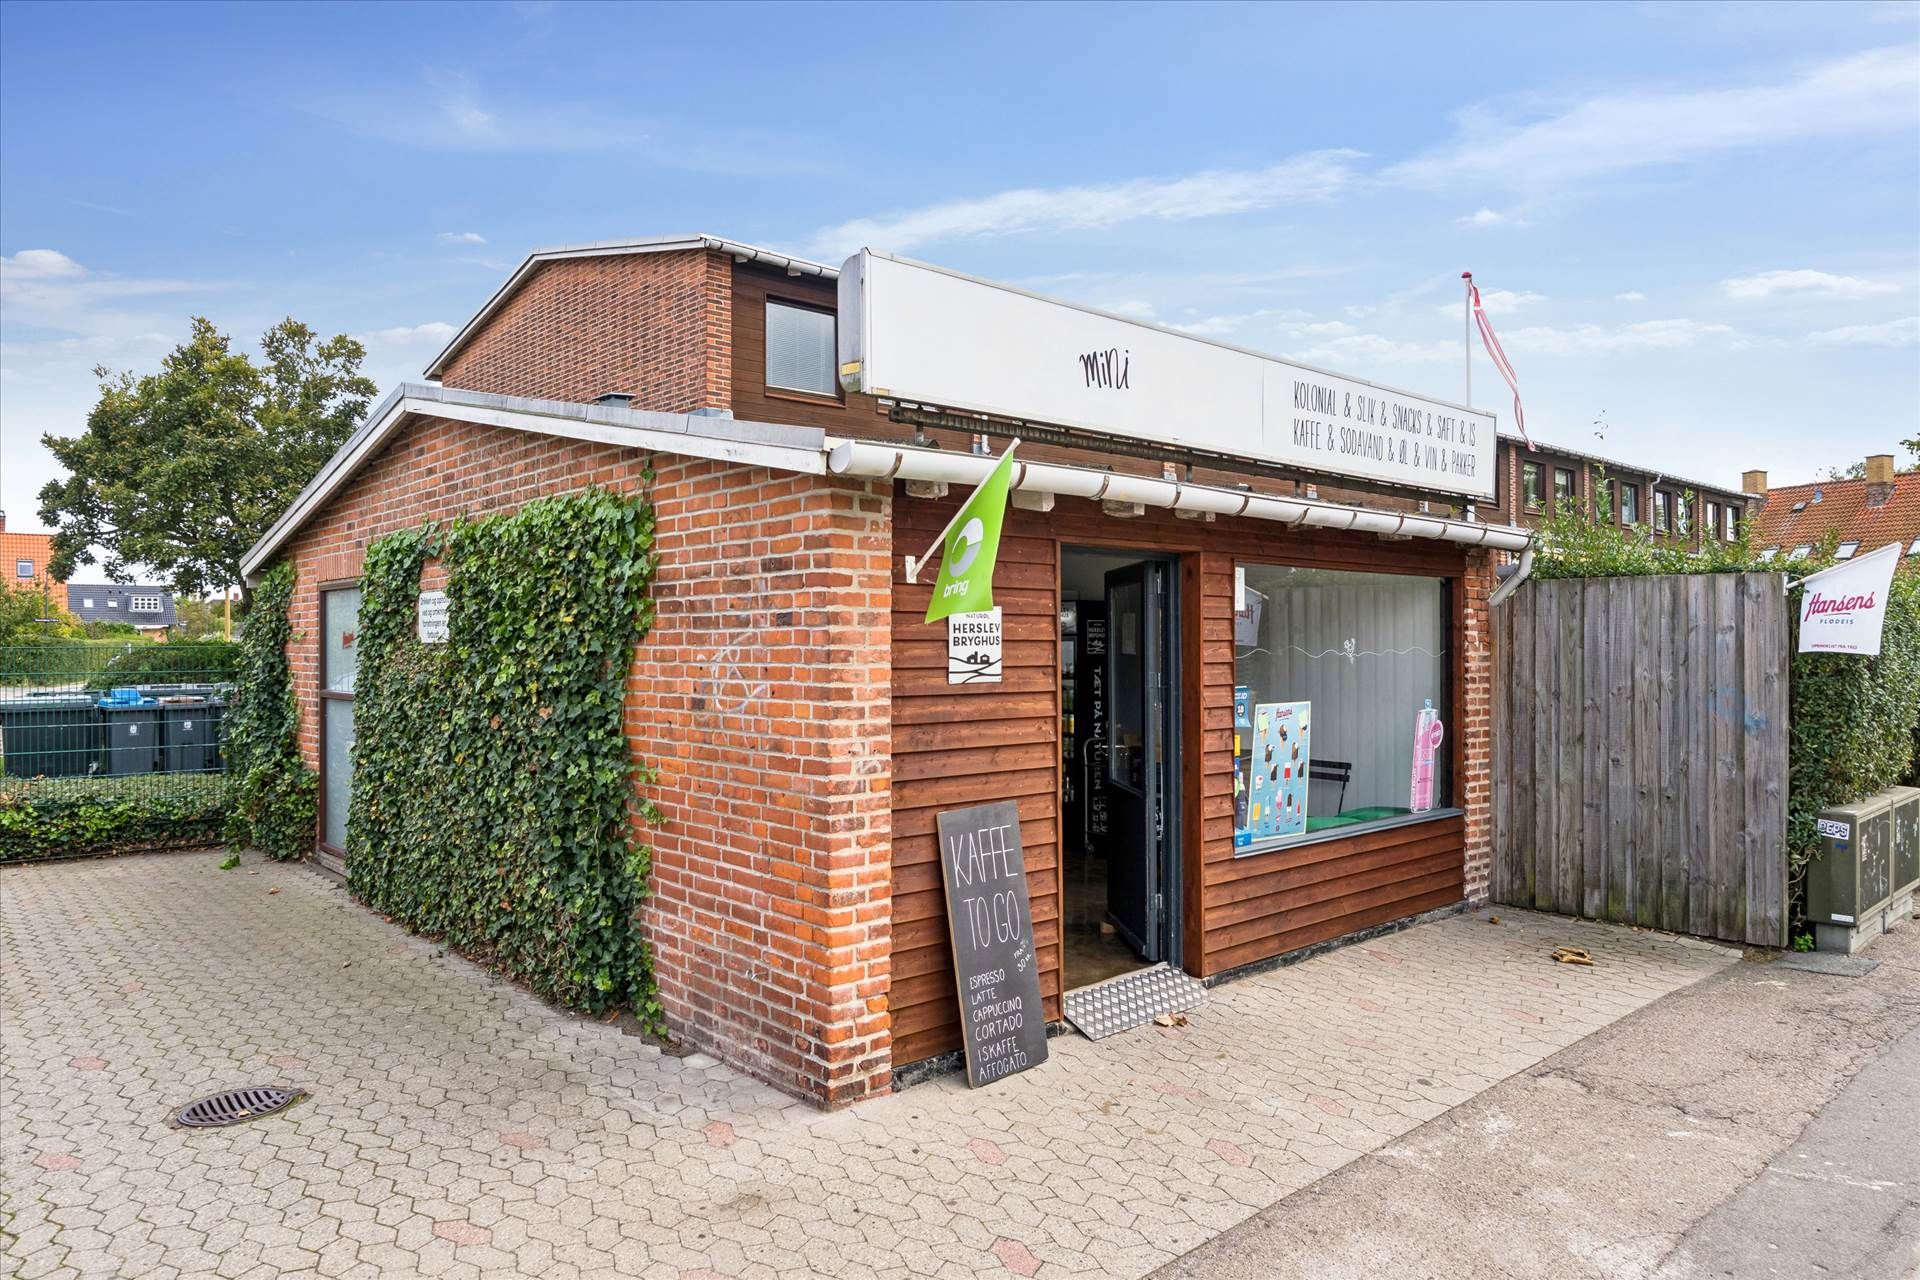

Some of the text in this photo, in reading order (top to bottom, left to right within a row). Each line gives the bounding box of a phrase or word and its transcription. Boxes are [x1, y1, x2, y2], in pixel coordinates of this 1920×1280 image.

[1294, 380, 1476, 447] KOLONIAL & SLIK & SNACKS & SAFT & IS
[1293, 418, 1476, 478] KAFFE & SODAVAND & ØL & VIN & PAKKER
[943, 580, 970, 598] bring
[1804, 592, 1876, 622] Hansens
[953, 623, 1000, 633] HERSLEV
[953, 636, 1000, 647] BRYGHUS
[950, 825, 1018, 888] KAFFE
[963, 890, 1020, 951] TO GO
[969, 968, 1005, 990] ESPRESSO
[971, 987, 997, 1006] LATTE
[973, 996, 1022, 1023] CAPPUCCINO
[975, 1013, 1023, 1042] CORTADO
[978, 1036, 1019, 1063] ISKAFFE
[979, 1051, 1027, 1081] AFFOGATO
